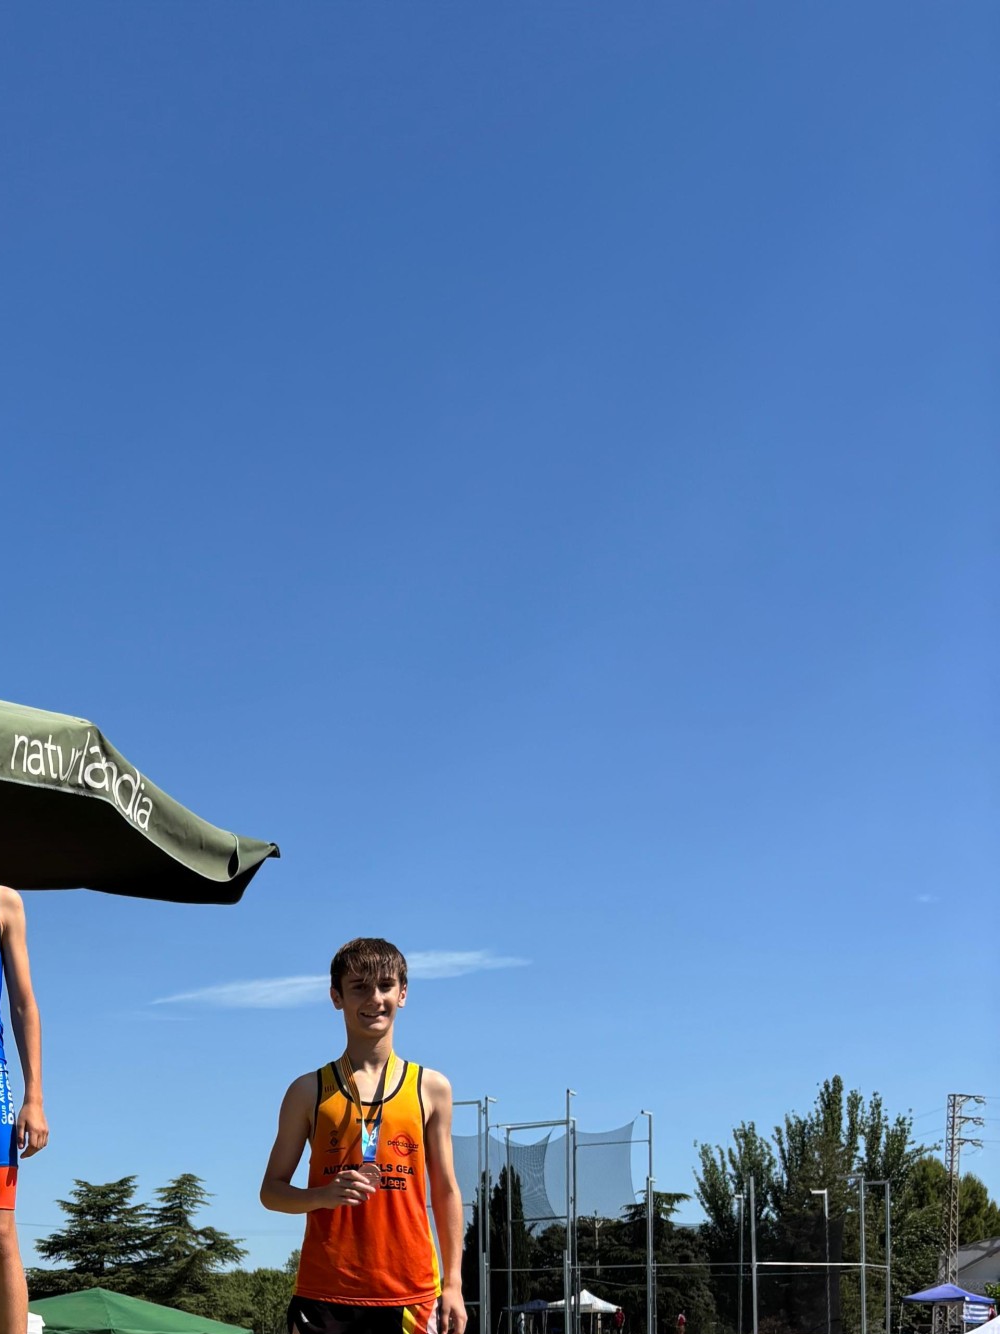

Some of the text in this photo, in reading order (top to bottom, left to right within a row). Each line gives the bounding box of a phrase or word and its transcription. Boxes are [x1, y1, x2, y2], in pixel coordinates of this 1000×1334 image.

[10, 731, 153, 831] naturlandia
[396, 1164, 414, 1176] GEA
[379, 1176, 407, 1191] Jeep
